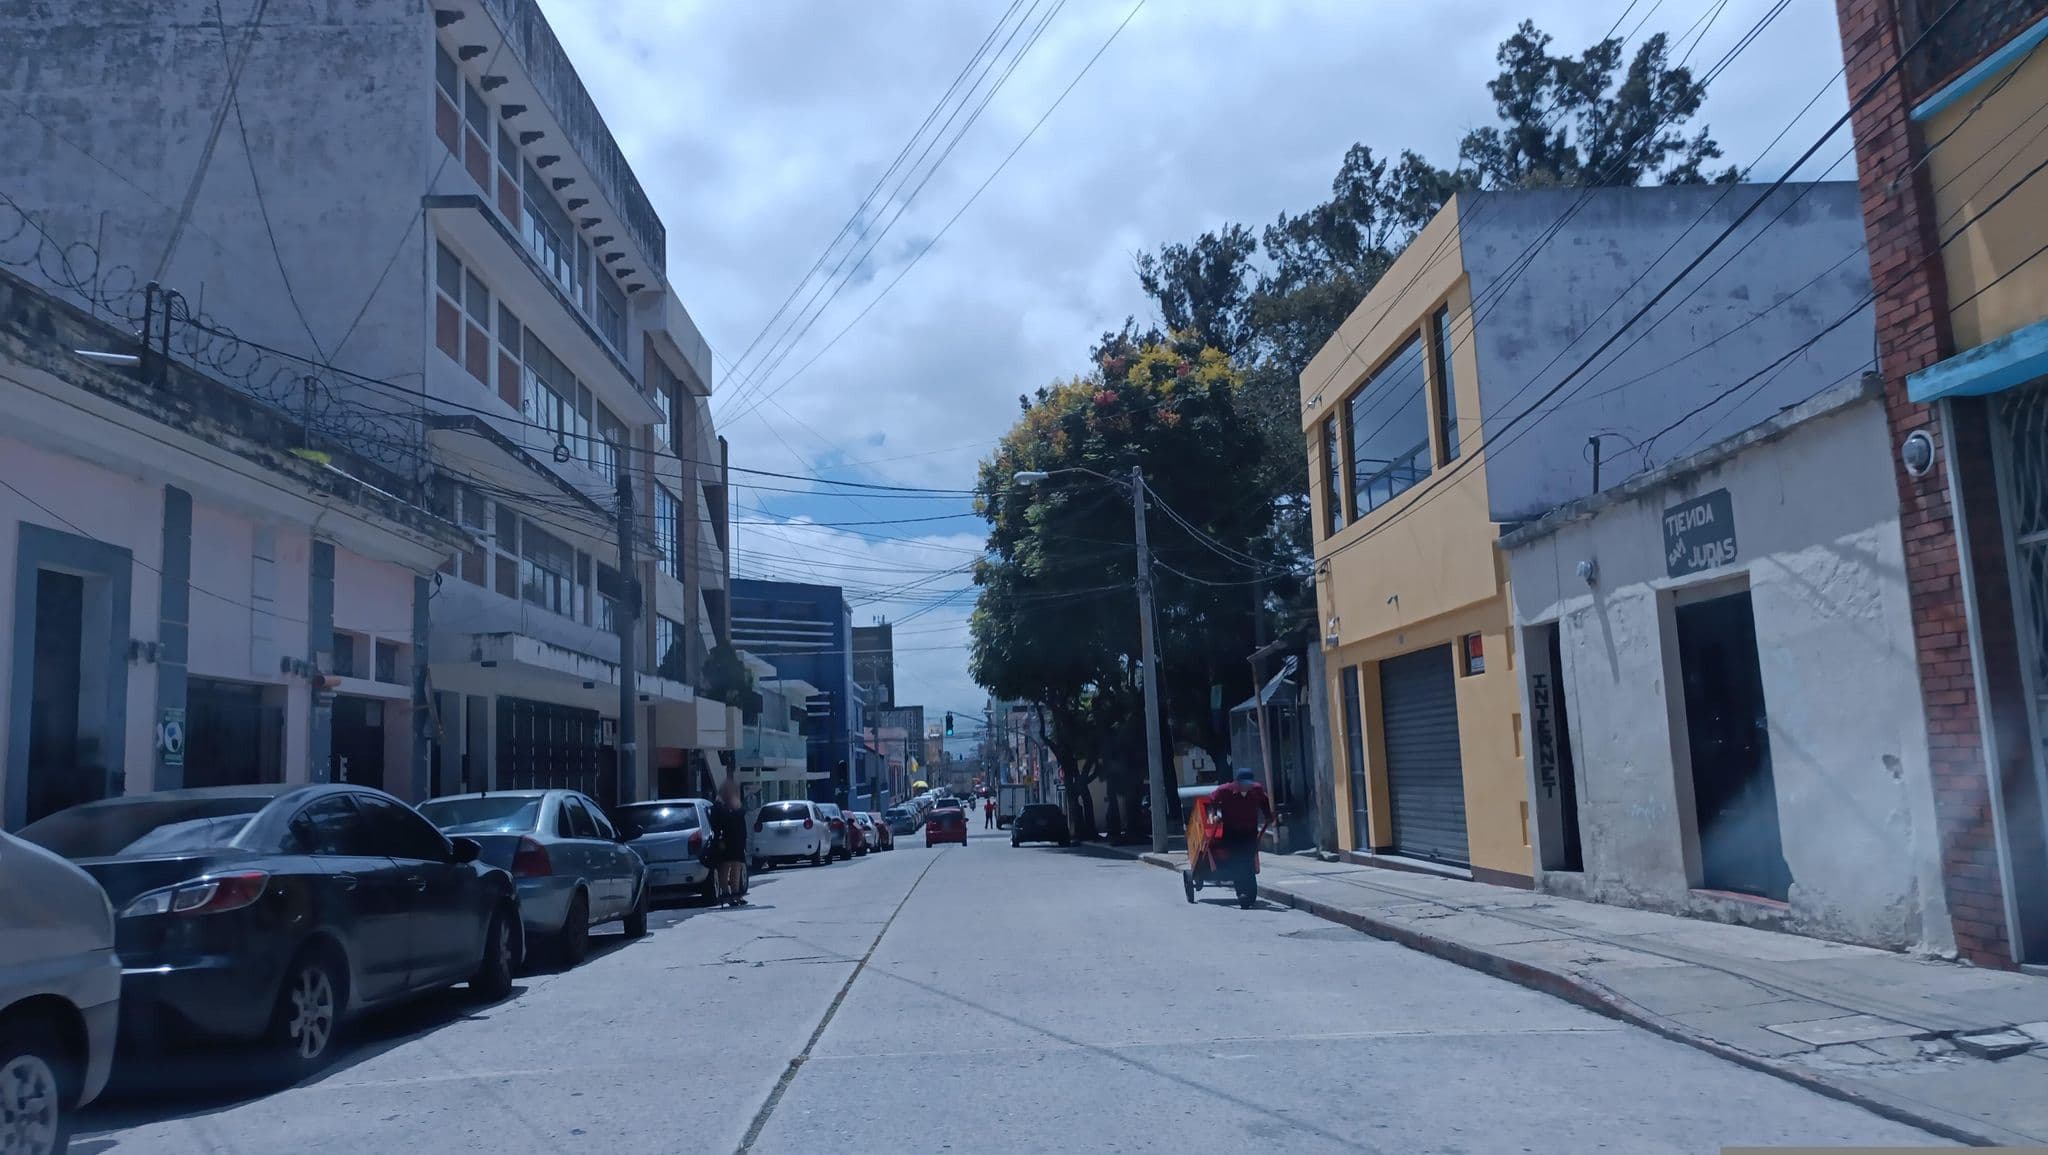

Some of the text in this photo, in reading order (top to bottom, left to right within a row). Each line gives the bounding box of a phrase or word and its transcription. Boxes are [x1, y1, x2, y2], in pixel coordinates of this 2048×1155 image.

[1665, 503, 1714, 537] TIENDA
[1688, 537, 1735, 569] JUDAS
[1532, 673, 1557, 799] INTERNET
